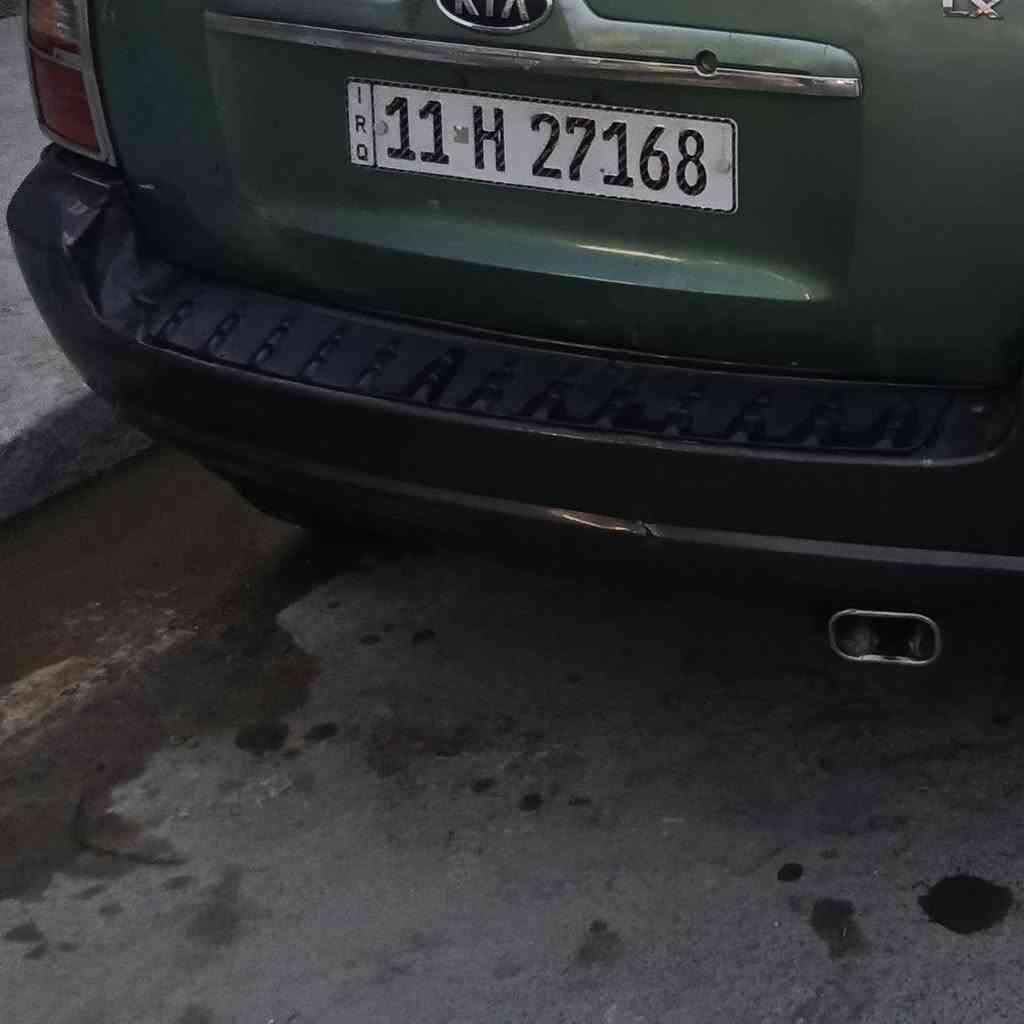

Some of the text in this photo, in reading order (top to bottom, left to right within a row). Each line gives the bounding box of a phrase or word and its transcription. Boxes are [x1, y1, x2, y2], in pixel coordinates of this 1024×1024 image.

[384, 95, 708, 197] 11 H 27168
